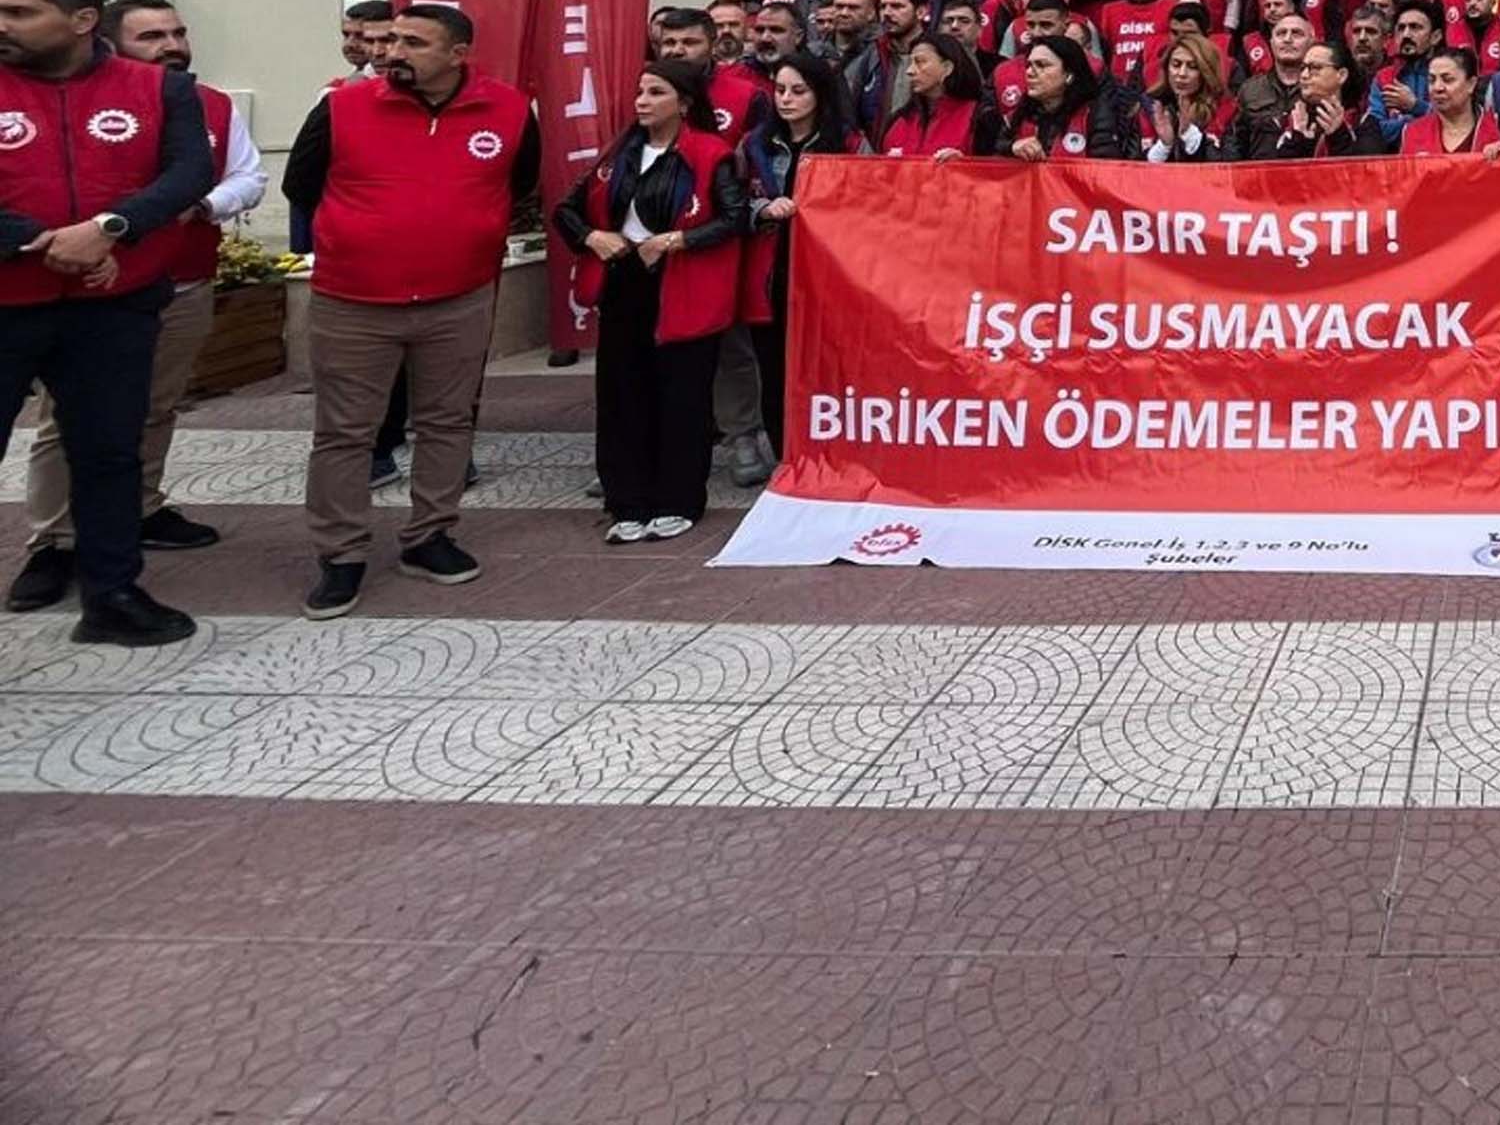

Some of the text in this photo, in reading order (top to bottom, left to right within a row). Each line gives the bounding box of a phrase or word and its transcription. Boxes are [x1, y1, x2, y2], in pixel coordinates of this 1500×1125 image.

[1046, 207, 1399, 268] SABIR TAŞTI !
[964, 291, 1474, 363] İŞÇİ SUSMAYACAK
[810, 386, 1028, 447] BİRİKEN
[1043, 389, 1358, 450] ÖDEMELER
[1033, 535, 1090, 549] DİSK
[1256, 542, 1282, 550] ve
[1144, 550, 1238, 565] Şubeler
